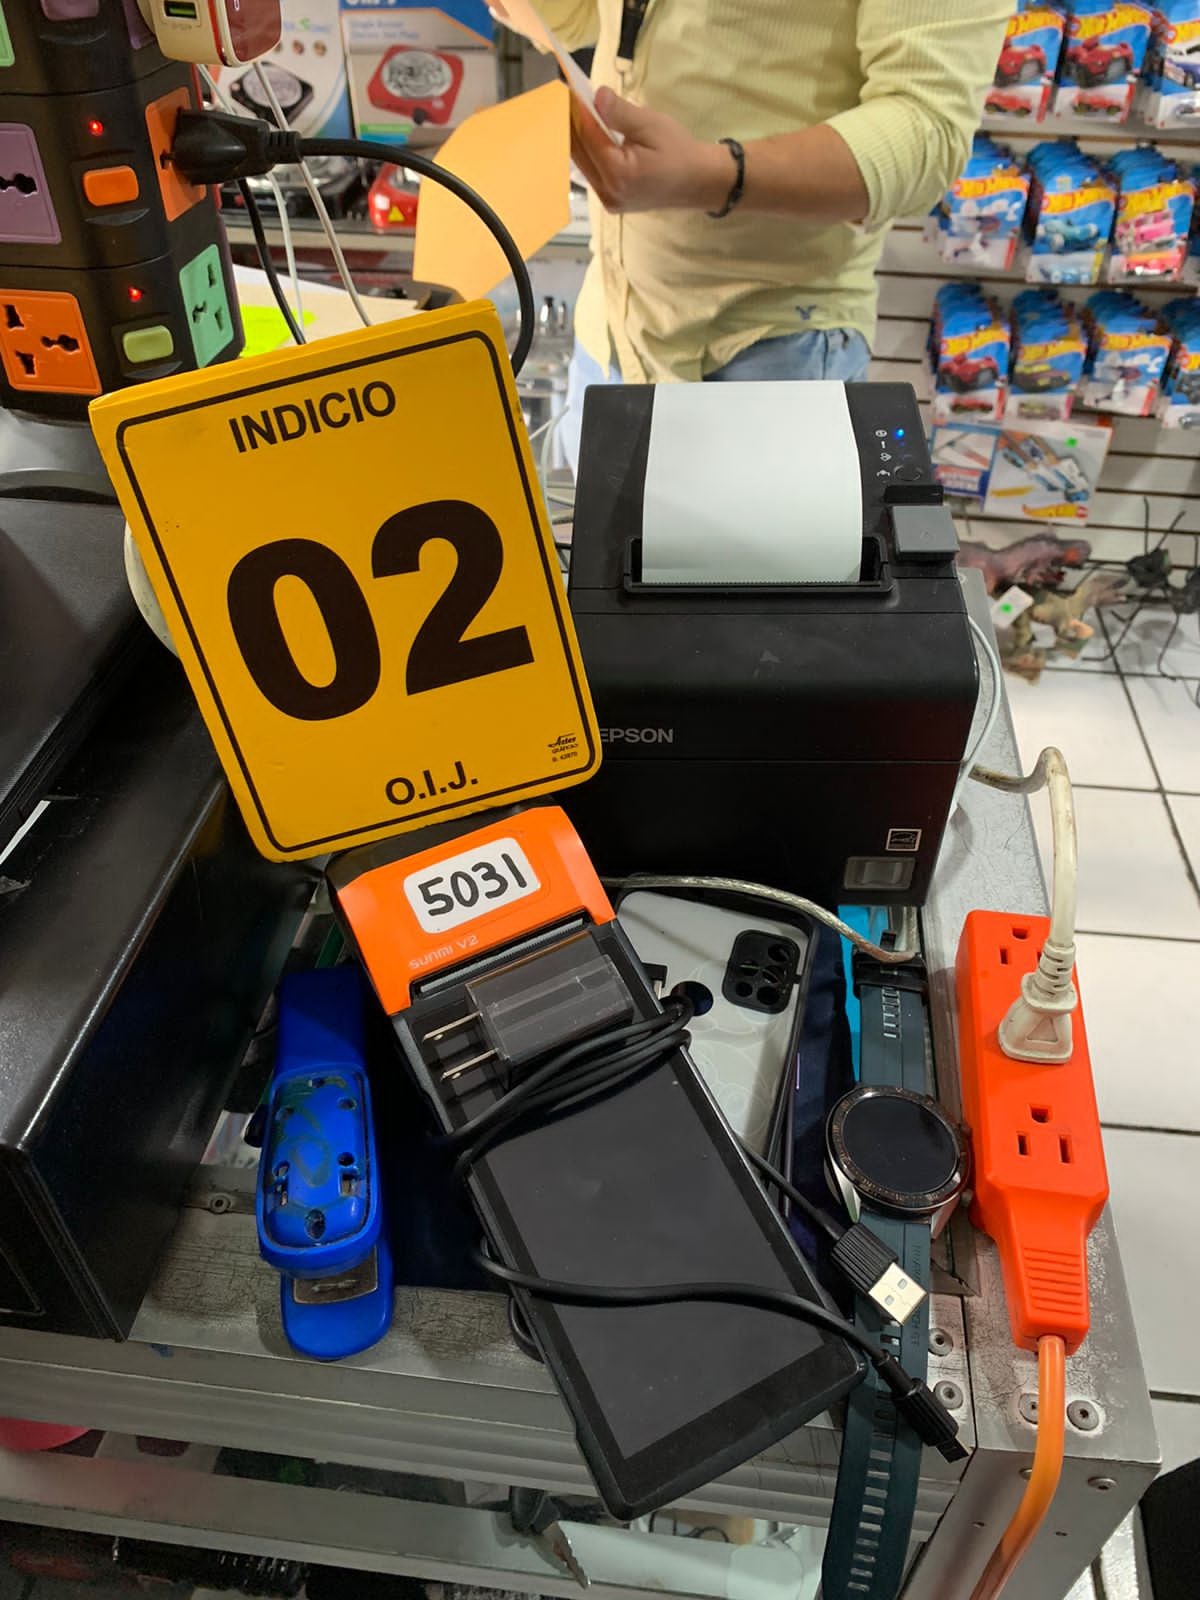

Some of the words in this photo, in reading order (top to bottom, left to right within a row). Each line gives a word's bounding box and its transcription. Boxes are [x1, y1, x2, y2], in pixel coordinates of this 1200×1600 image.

[228, 381, 397, 454] INDICIO
[227, 499, 535, 722] 02
[599, 727, 674, 744] EPSON
[385, 760, 479, 806] O.I.J.
[418, 853, 527, 917] 5031
[456, 934, 479, 950] V2
